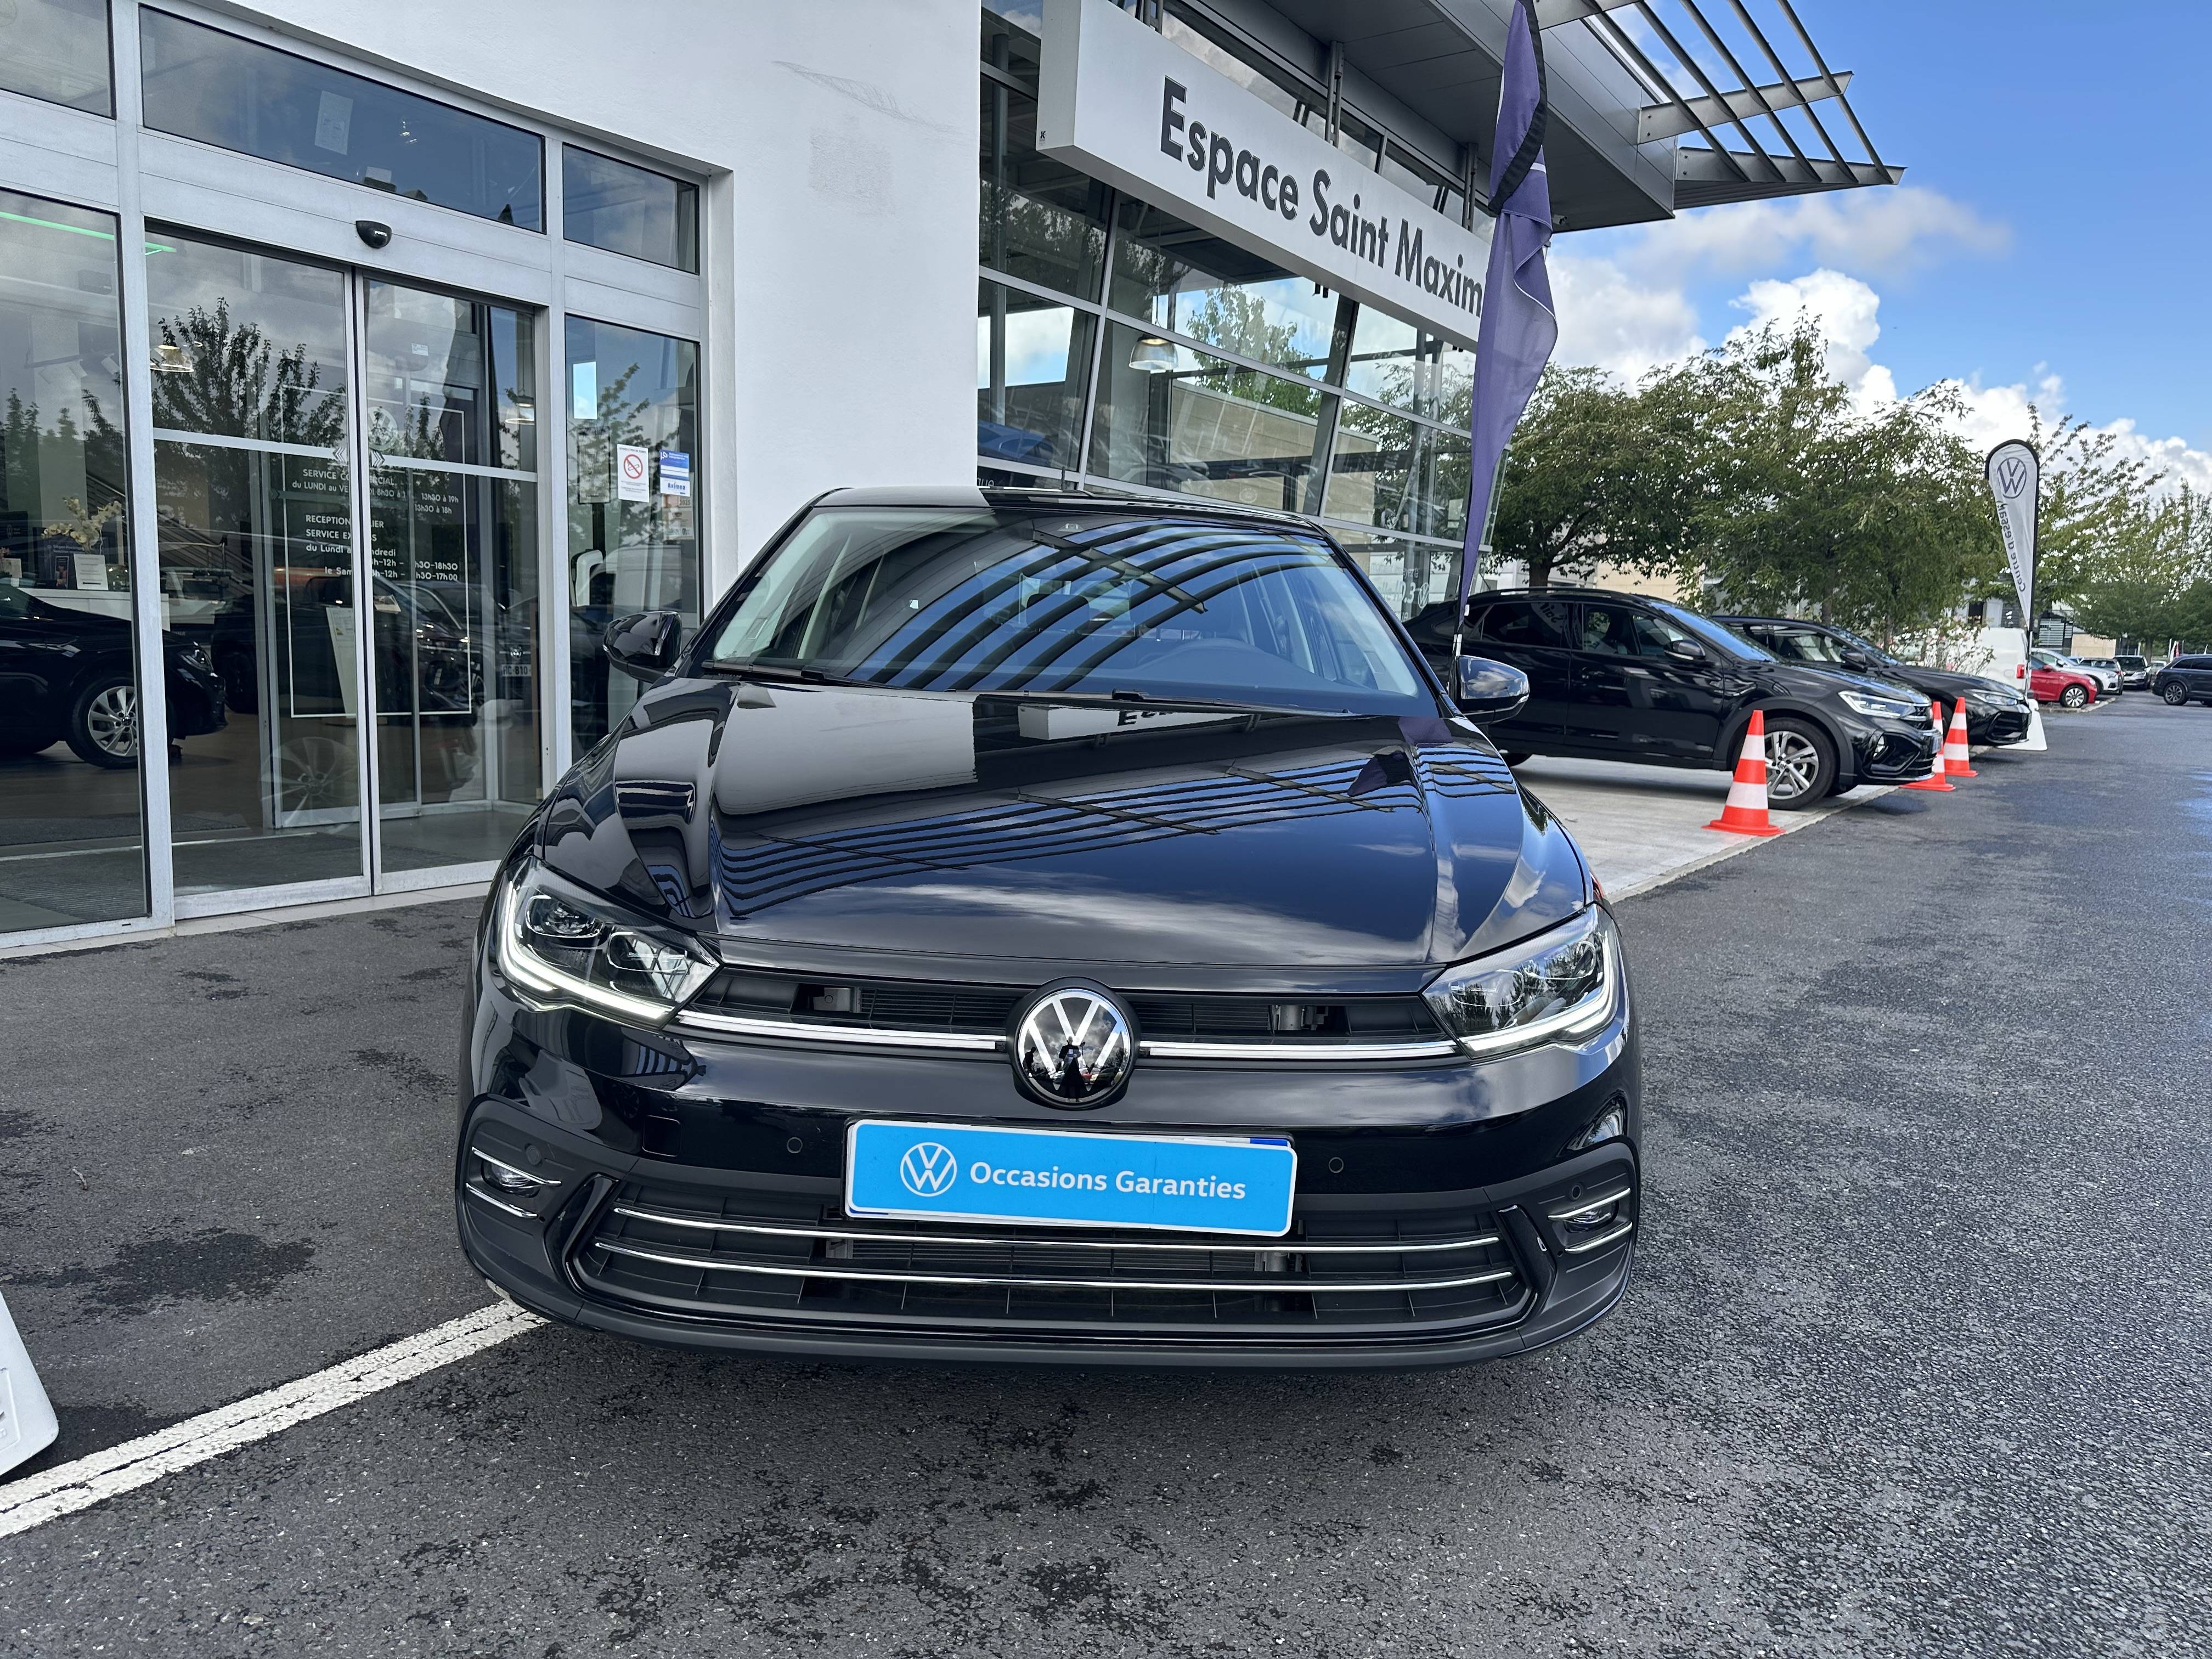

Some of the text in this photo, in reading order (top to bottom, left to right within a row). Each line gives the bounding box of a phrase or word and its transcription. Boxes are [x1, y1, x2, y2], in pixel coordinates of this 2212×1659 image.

[1160, 75, 1482, 318] Espace Saint Maxim
[303, 469, 337, 479] SERVICE
[304, 481, 326, 491] LUNDI
[421, 493, 441, 501] 13h30
[414, 504, 435, 512] 13h30
[306, 515, 351, 526] RECEPTION
[306, 529, 339, 539] SERVICE
[306, 543, 317, 552] du
[415, 560, 458, 571] h30-18h30
[325, 566, 332, 574] le
[416, 571, 458, 581] h30-17h00
[970, 1161, 1107, 1192] Occasions
[1115, 1170, 1246, 1199] Garanties
